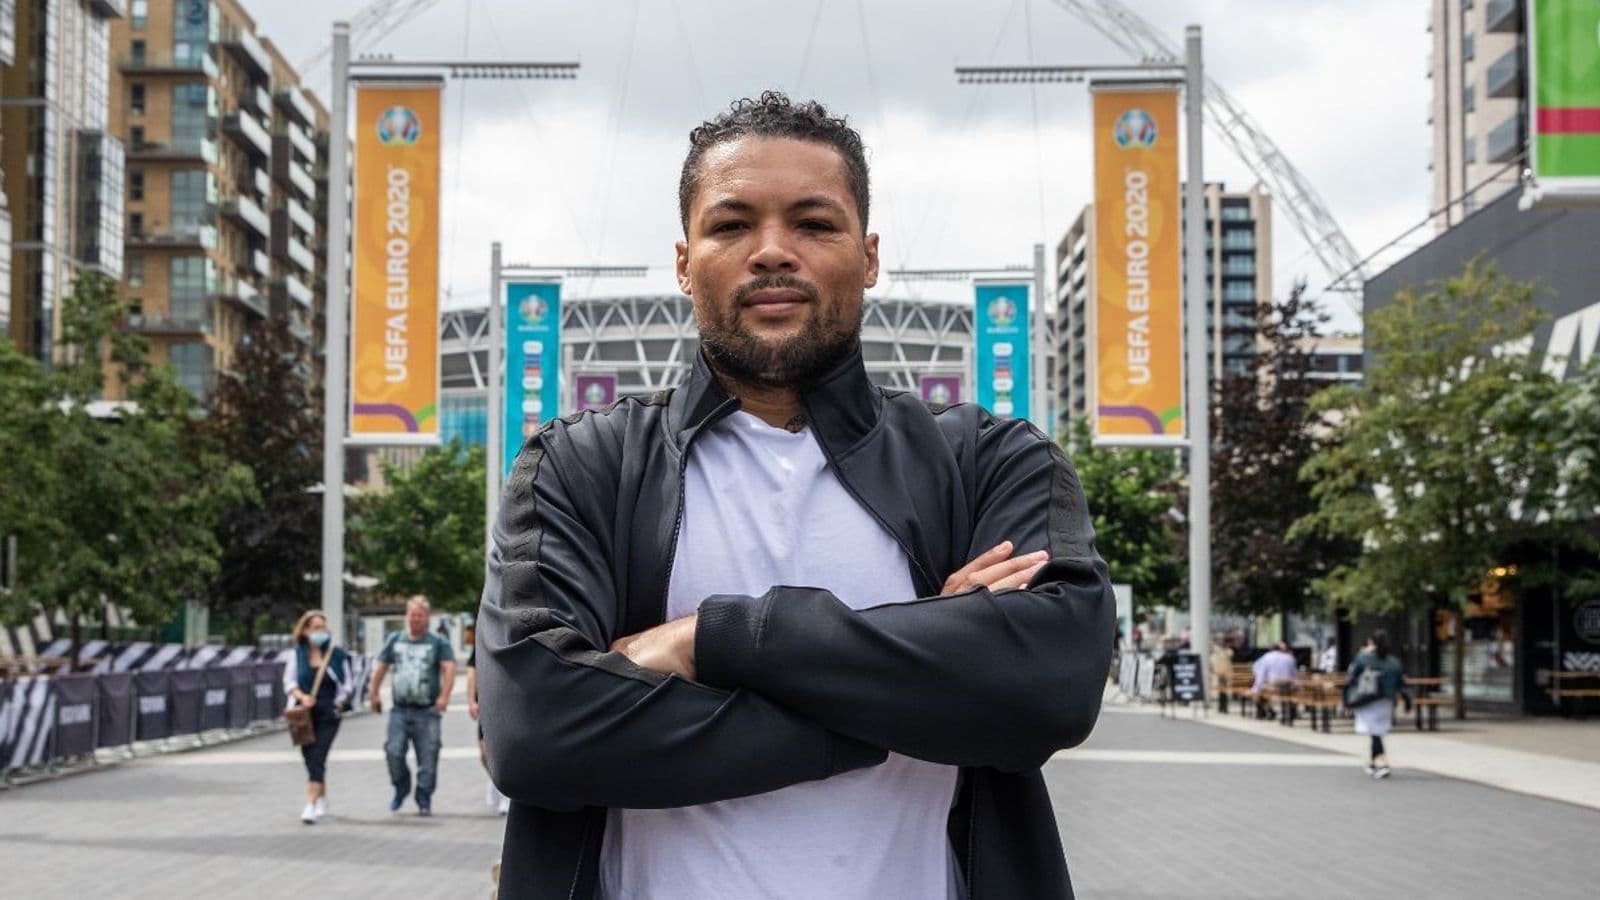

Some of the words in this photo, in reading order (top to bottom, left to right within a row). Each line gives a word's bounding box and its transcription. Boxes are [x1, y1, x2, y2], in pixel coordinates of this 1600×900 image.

[387, 168, 410, 235] 2020
[1126, 171, 1149, 237] 2020
[386, 238, 409, 310] EURO
[1127, 241, 1150, 313] EURO
[385, 314, 409, 383] UEFA
[1128, 317, 1151, 384] UEFA
